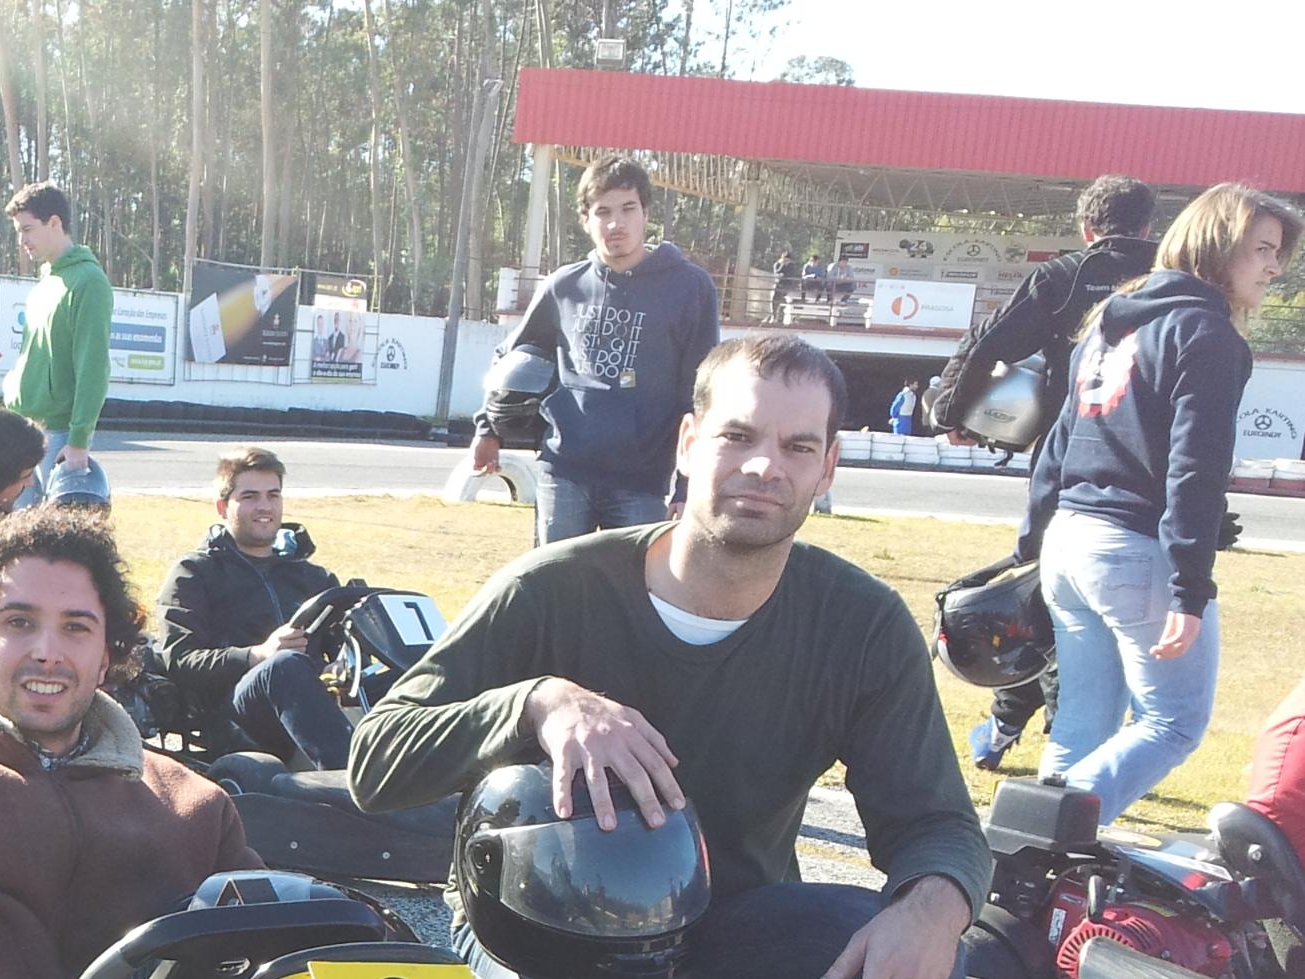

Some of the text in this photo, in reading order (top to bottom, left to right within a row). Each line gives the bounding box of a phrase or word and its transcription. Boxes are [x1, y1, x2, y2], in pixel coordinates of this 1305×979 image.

[572, 303, 646, 327] JUST DO IT
[629, 326, 643, 342] IT
[626, 340, 640, 356] IT
[596, 349, 622, 365] DO
[594, 362, 619, 379] DO
